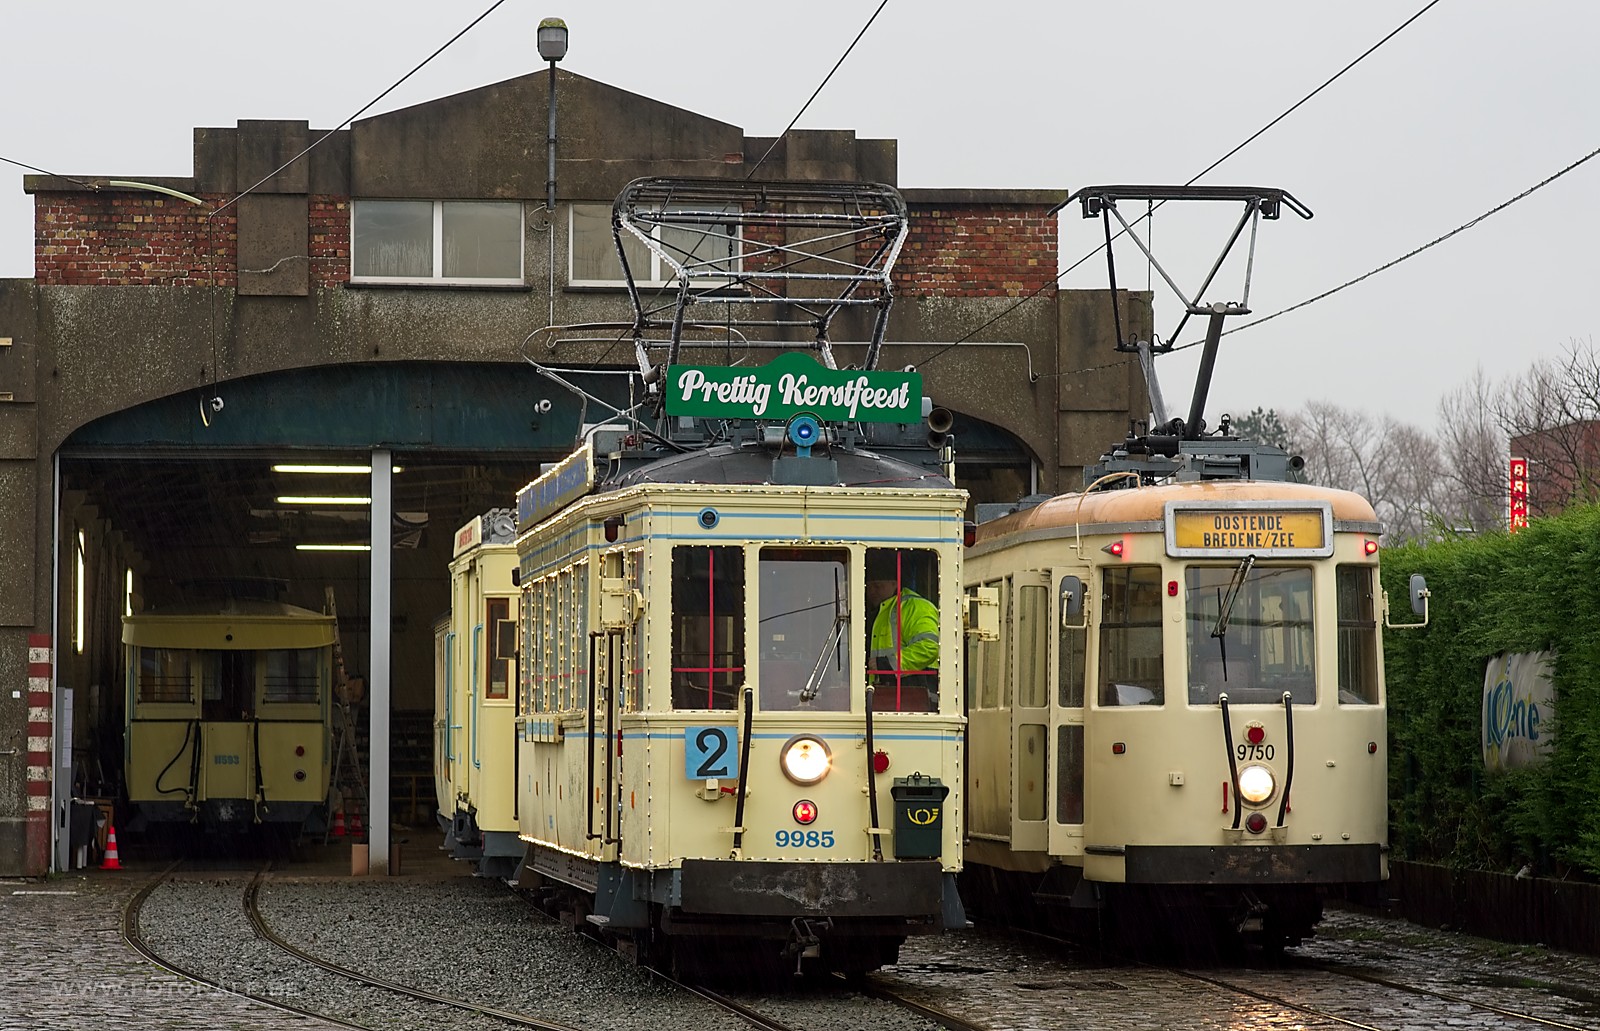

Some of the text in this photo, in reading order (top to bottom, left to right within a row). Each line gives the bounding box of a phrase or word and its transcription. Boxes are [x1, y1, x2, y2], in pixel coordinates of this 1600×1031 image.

[678, 369, 910, 419] Prettig Kerstfeest
[1214, 515, 1283, 531] OOSTENDE
[1203, 533, 1295, 548] BREDENE/ZEE
[696, 728, 728, 777] 2
[1237, 744, 1275, 761] 9750
[775, 829, 835, 848] 9985
